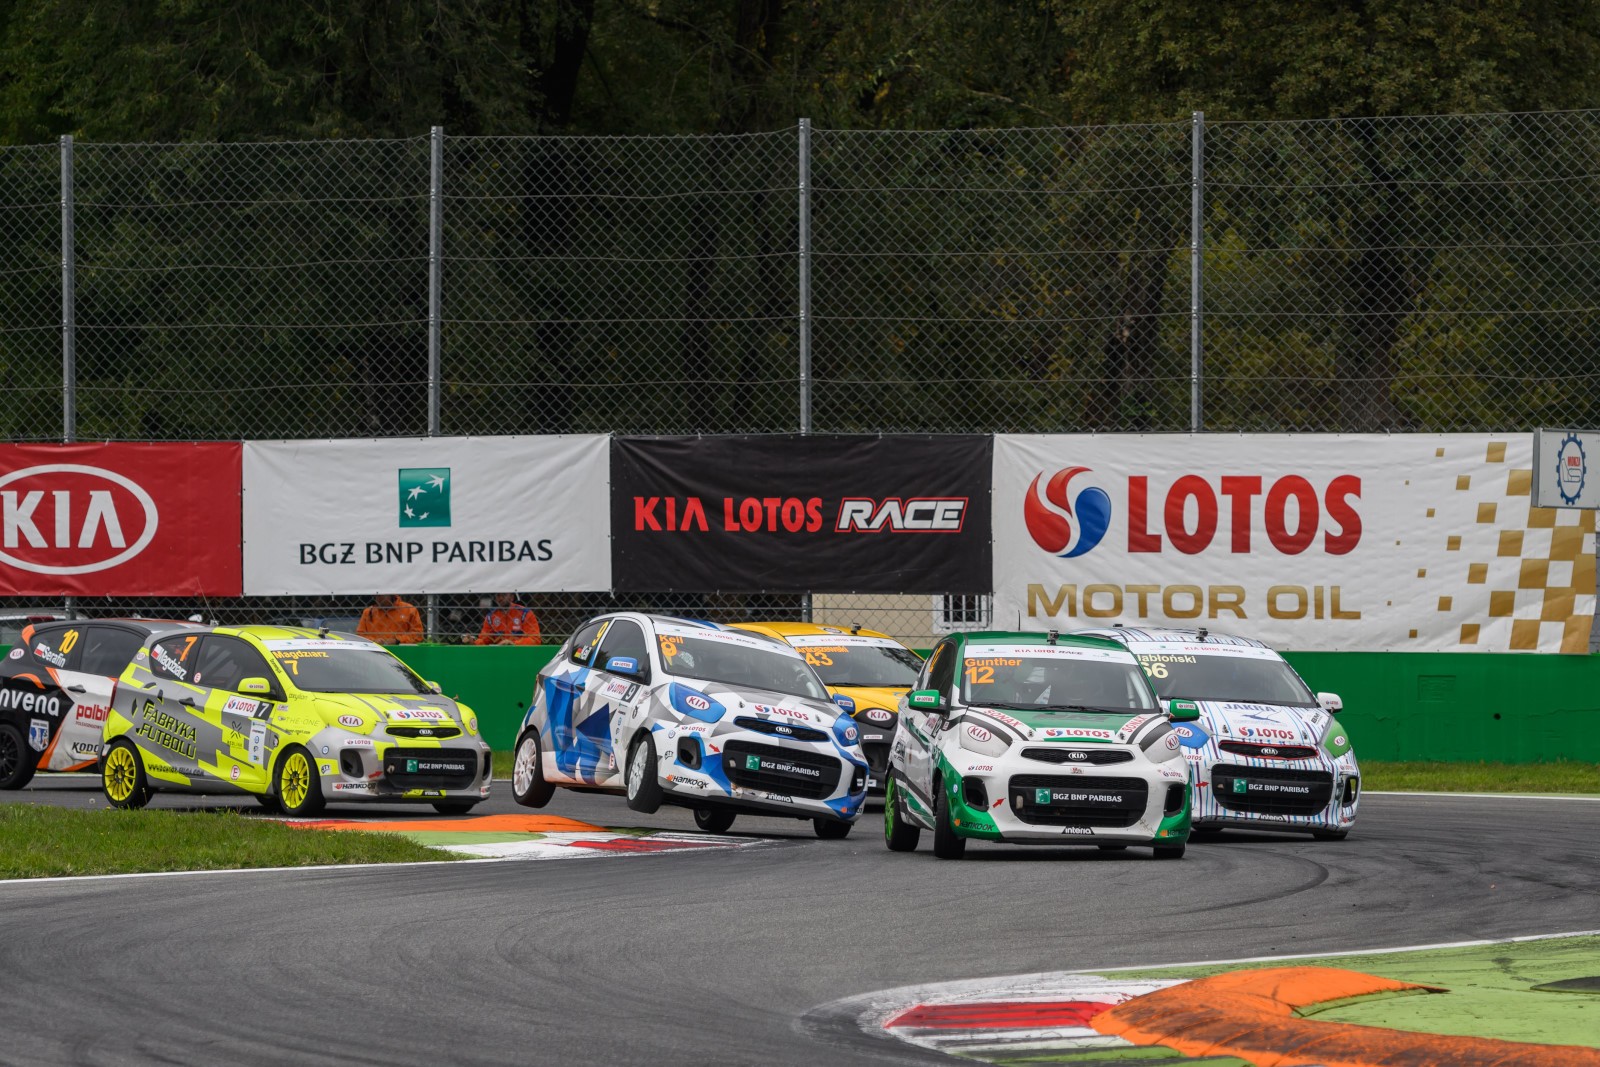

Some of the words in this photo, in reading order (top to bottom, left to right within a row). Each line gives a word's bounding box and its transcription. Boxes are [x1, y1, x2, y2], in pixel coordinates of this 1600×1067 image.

[1, 490, 127, 549] KIA
[633, 496, 709, 532] KIA
[724, 496, 823, 532] LOTOS
[836, 497, 968, 533] RACE
[1128, 474, 1362, 556] LOTOS
[365, 541, 424, 565] BNP
[431, 539, 554, 565] PARIBAS
[1027, 583, 1248, 619] MOTOR
[1266, 585, 1362, 620] OIL
[591, 621, 609, 646] 9
[659, 634, 684, 644] Keil
[58, 629, 79, 654] 10
[179, 636, 198, 662] 7
[271, 650, 329, 660] Magdziarz
[660, 641, 677, 657] 9
[42, 646, 67, 669] Serafin
[805, 652, 834, 667] 43
[964, 658, 1023, 668] Gunther
[284, 660, 299, 675] 7
[964, 667, 995, 684] 12
[235, 700, 256, 713] LOTOS
[688, 696, 706, 709] KIA
[257, 702, 270, 718] 7
[410, 710, 443, 720] LOTOS
[771, 706, 810, 721] LOTOS
[870, 711, 888, 720] KIA
[143, 702, 197, 744] FABRYKA
[342, 716, 359, 726] KIA
[984, 709, 1023, 727] SONAX
[1121, 713, 1147, 733] SONAX
[778, 726, 791, 734] KIA
[846, 729, 857, 738] KIA
[970, 727, 987, 741] KIA
[1066, 729, 1110, 738] LOTOS
[1177, 727, 1190, 737] KIA
[1255, 727, 1295, 740] LOTOS
[139, 722, 197, 760] FUTBOLU
[1168, 736, 1179, 748] KIA
[1070, 752, 1085, 760] KIA
[232, 767, 238, 778] E
[442, 763, 465, 771] PARIBAS
[776, 763, 791, 772] BNP
[791, 766, 820, 777] PARIBAS
[1264, 784, 1280, 792] BNP
[1280, 785, 1310, 794] PARIBAS
[768, 794, 791, 804] interia
[1070, 793, 1088, 801] BNP
[1088, 795, 1123, 803] PARIBAS
[1065, 826, 1092, 835] interia
